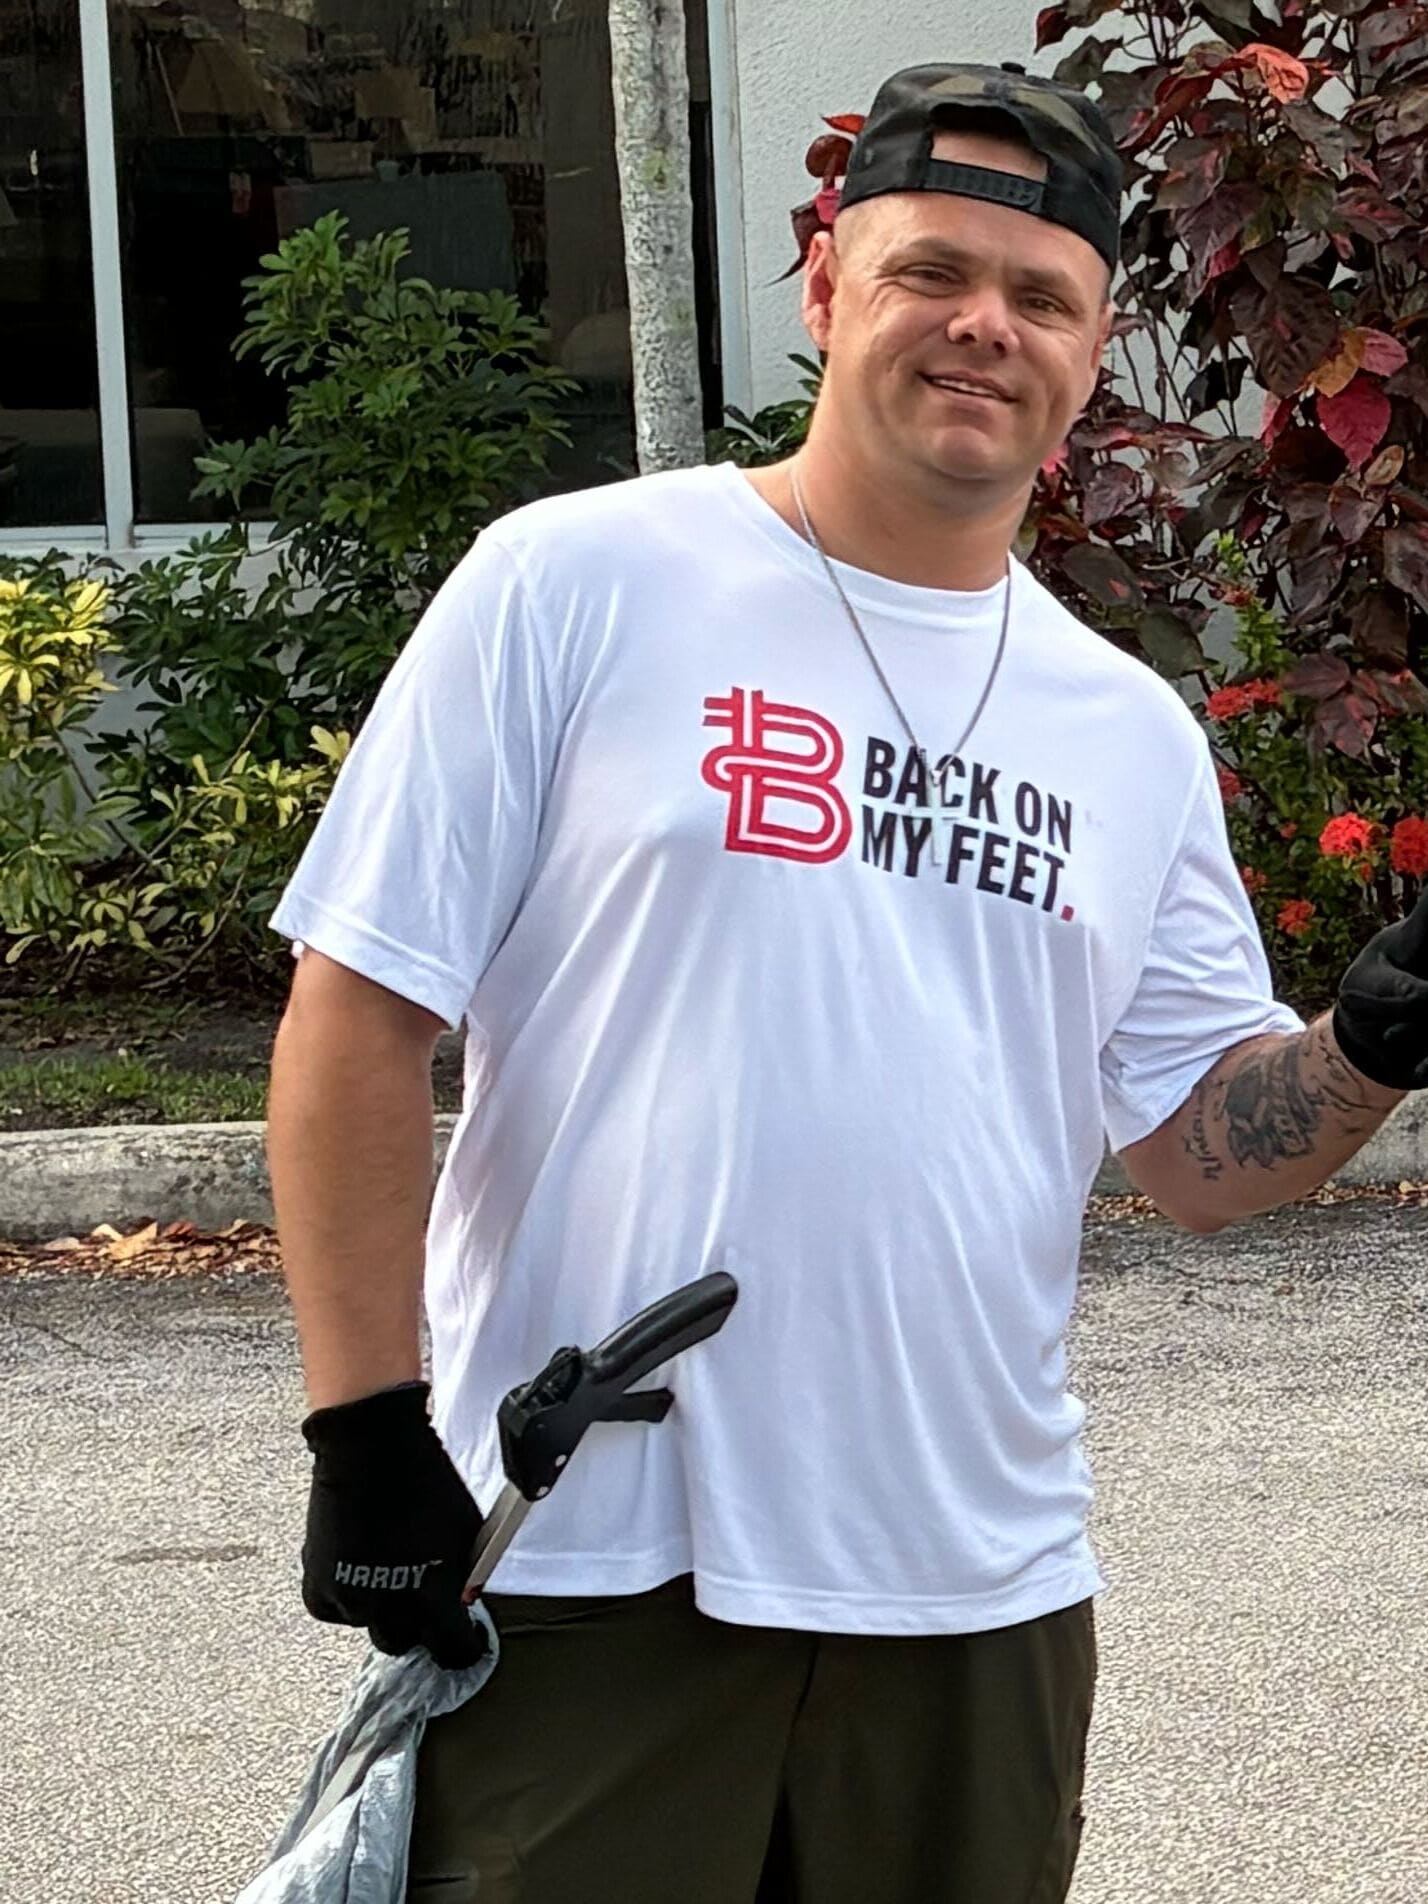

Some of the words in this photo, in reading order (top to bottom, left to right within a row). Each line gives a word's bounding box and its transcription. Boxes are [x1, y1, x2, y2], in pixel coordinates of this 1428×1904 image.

[862, 735, 1002, 826] BACK
[1014, 780, 1073, 855] ON
[860, 803, 933, 879] MY
[945, 823, 1075, 922] FEET.
[334, 1560, 428, 1591] HARDY
